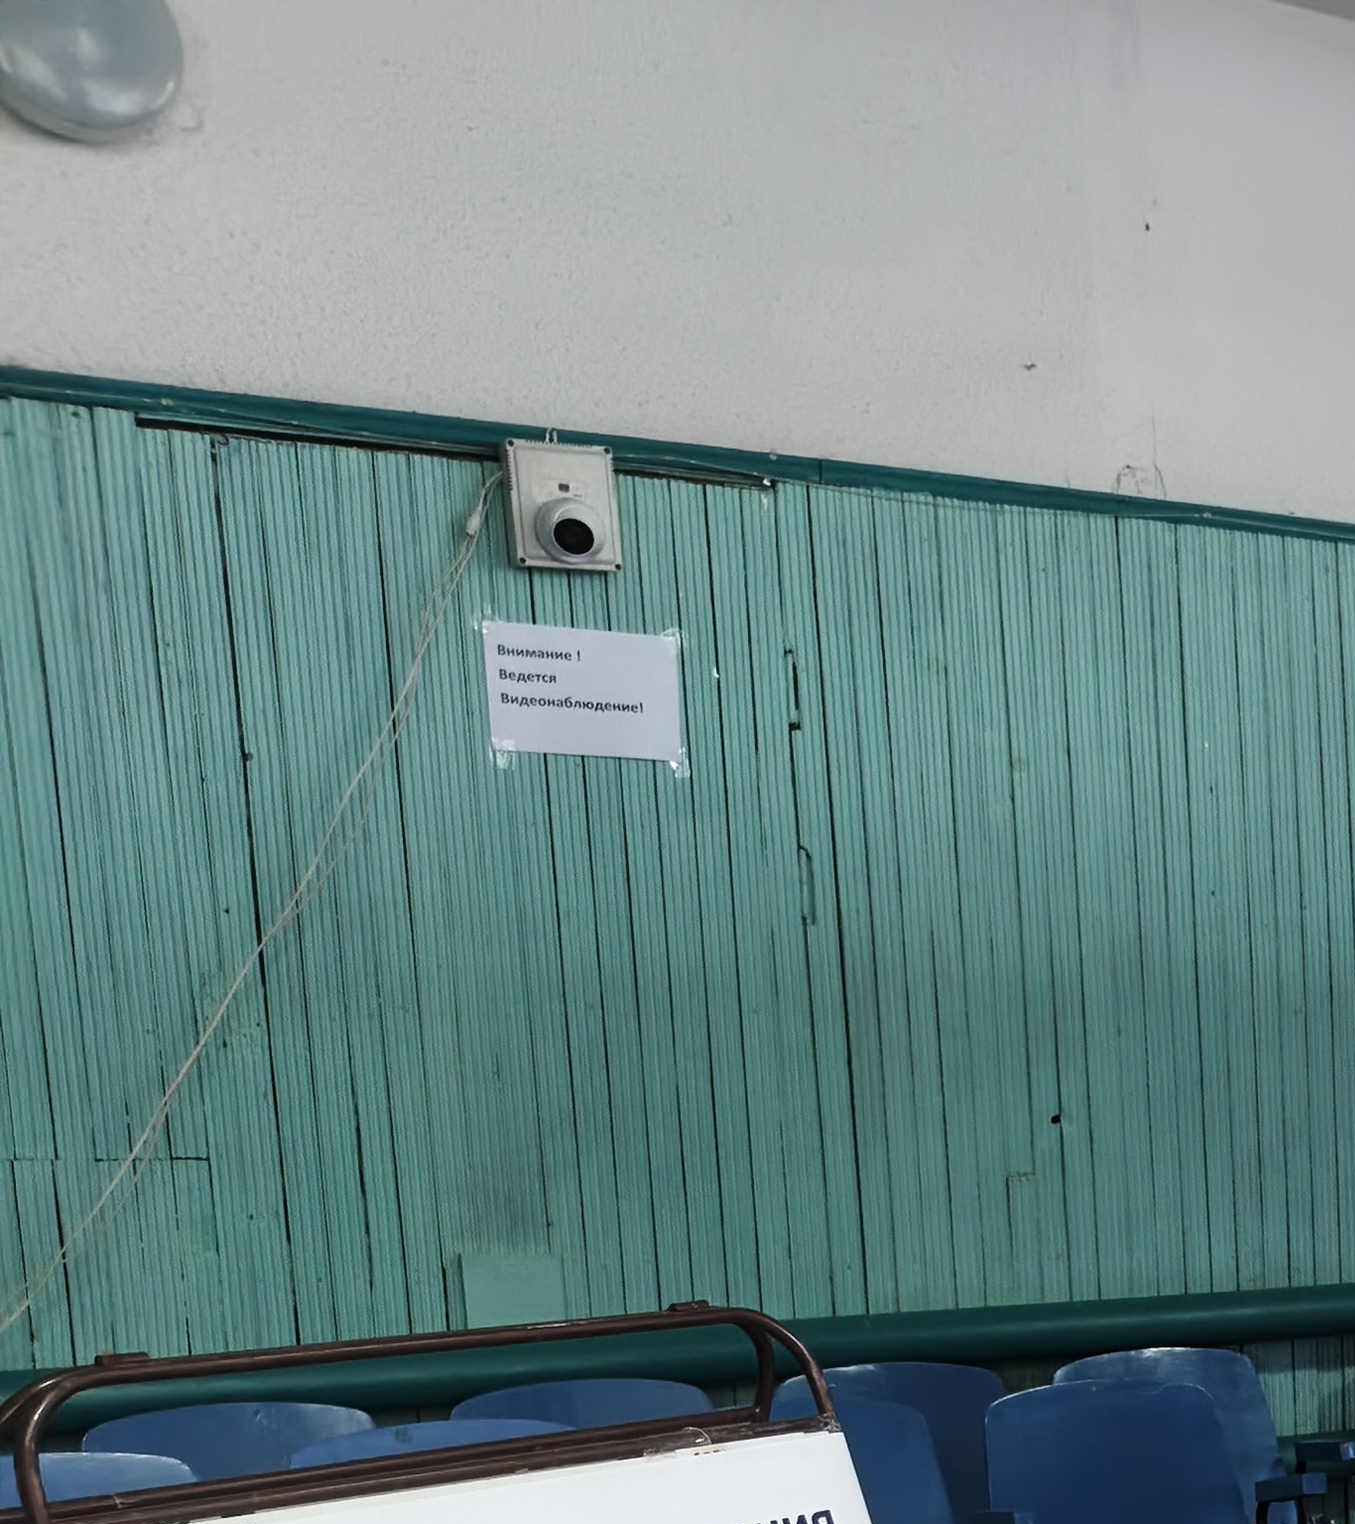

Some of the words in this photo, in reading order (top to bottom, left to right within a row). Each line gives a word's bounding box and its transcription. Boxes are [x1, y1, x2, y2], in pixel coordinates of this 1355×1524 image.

[497, 645, 572, 661] Внимание
[499, 669, 557, 684] Ведется
[501, 693, 644, 713] Видеонаблюдение!
